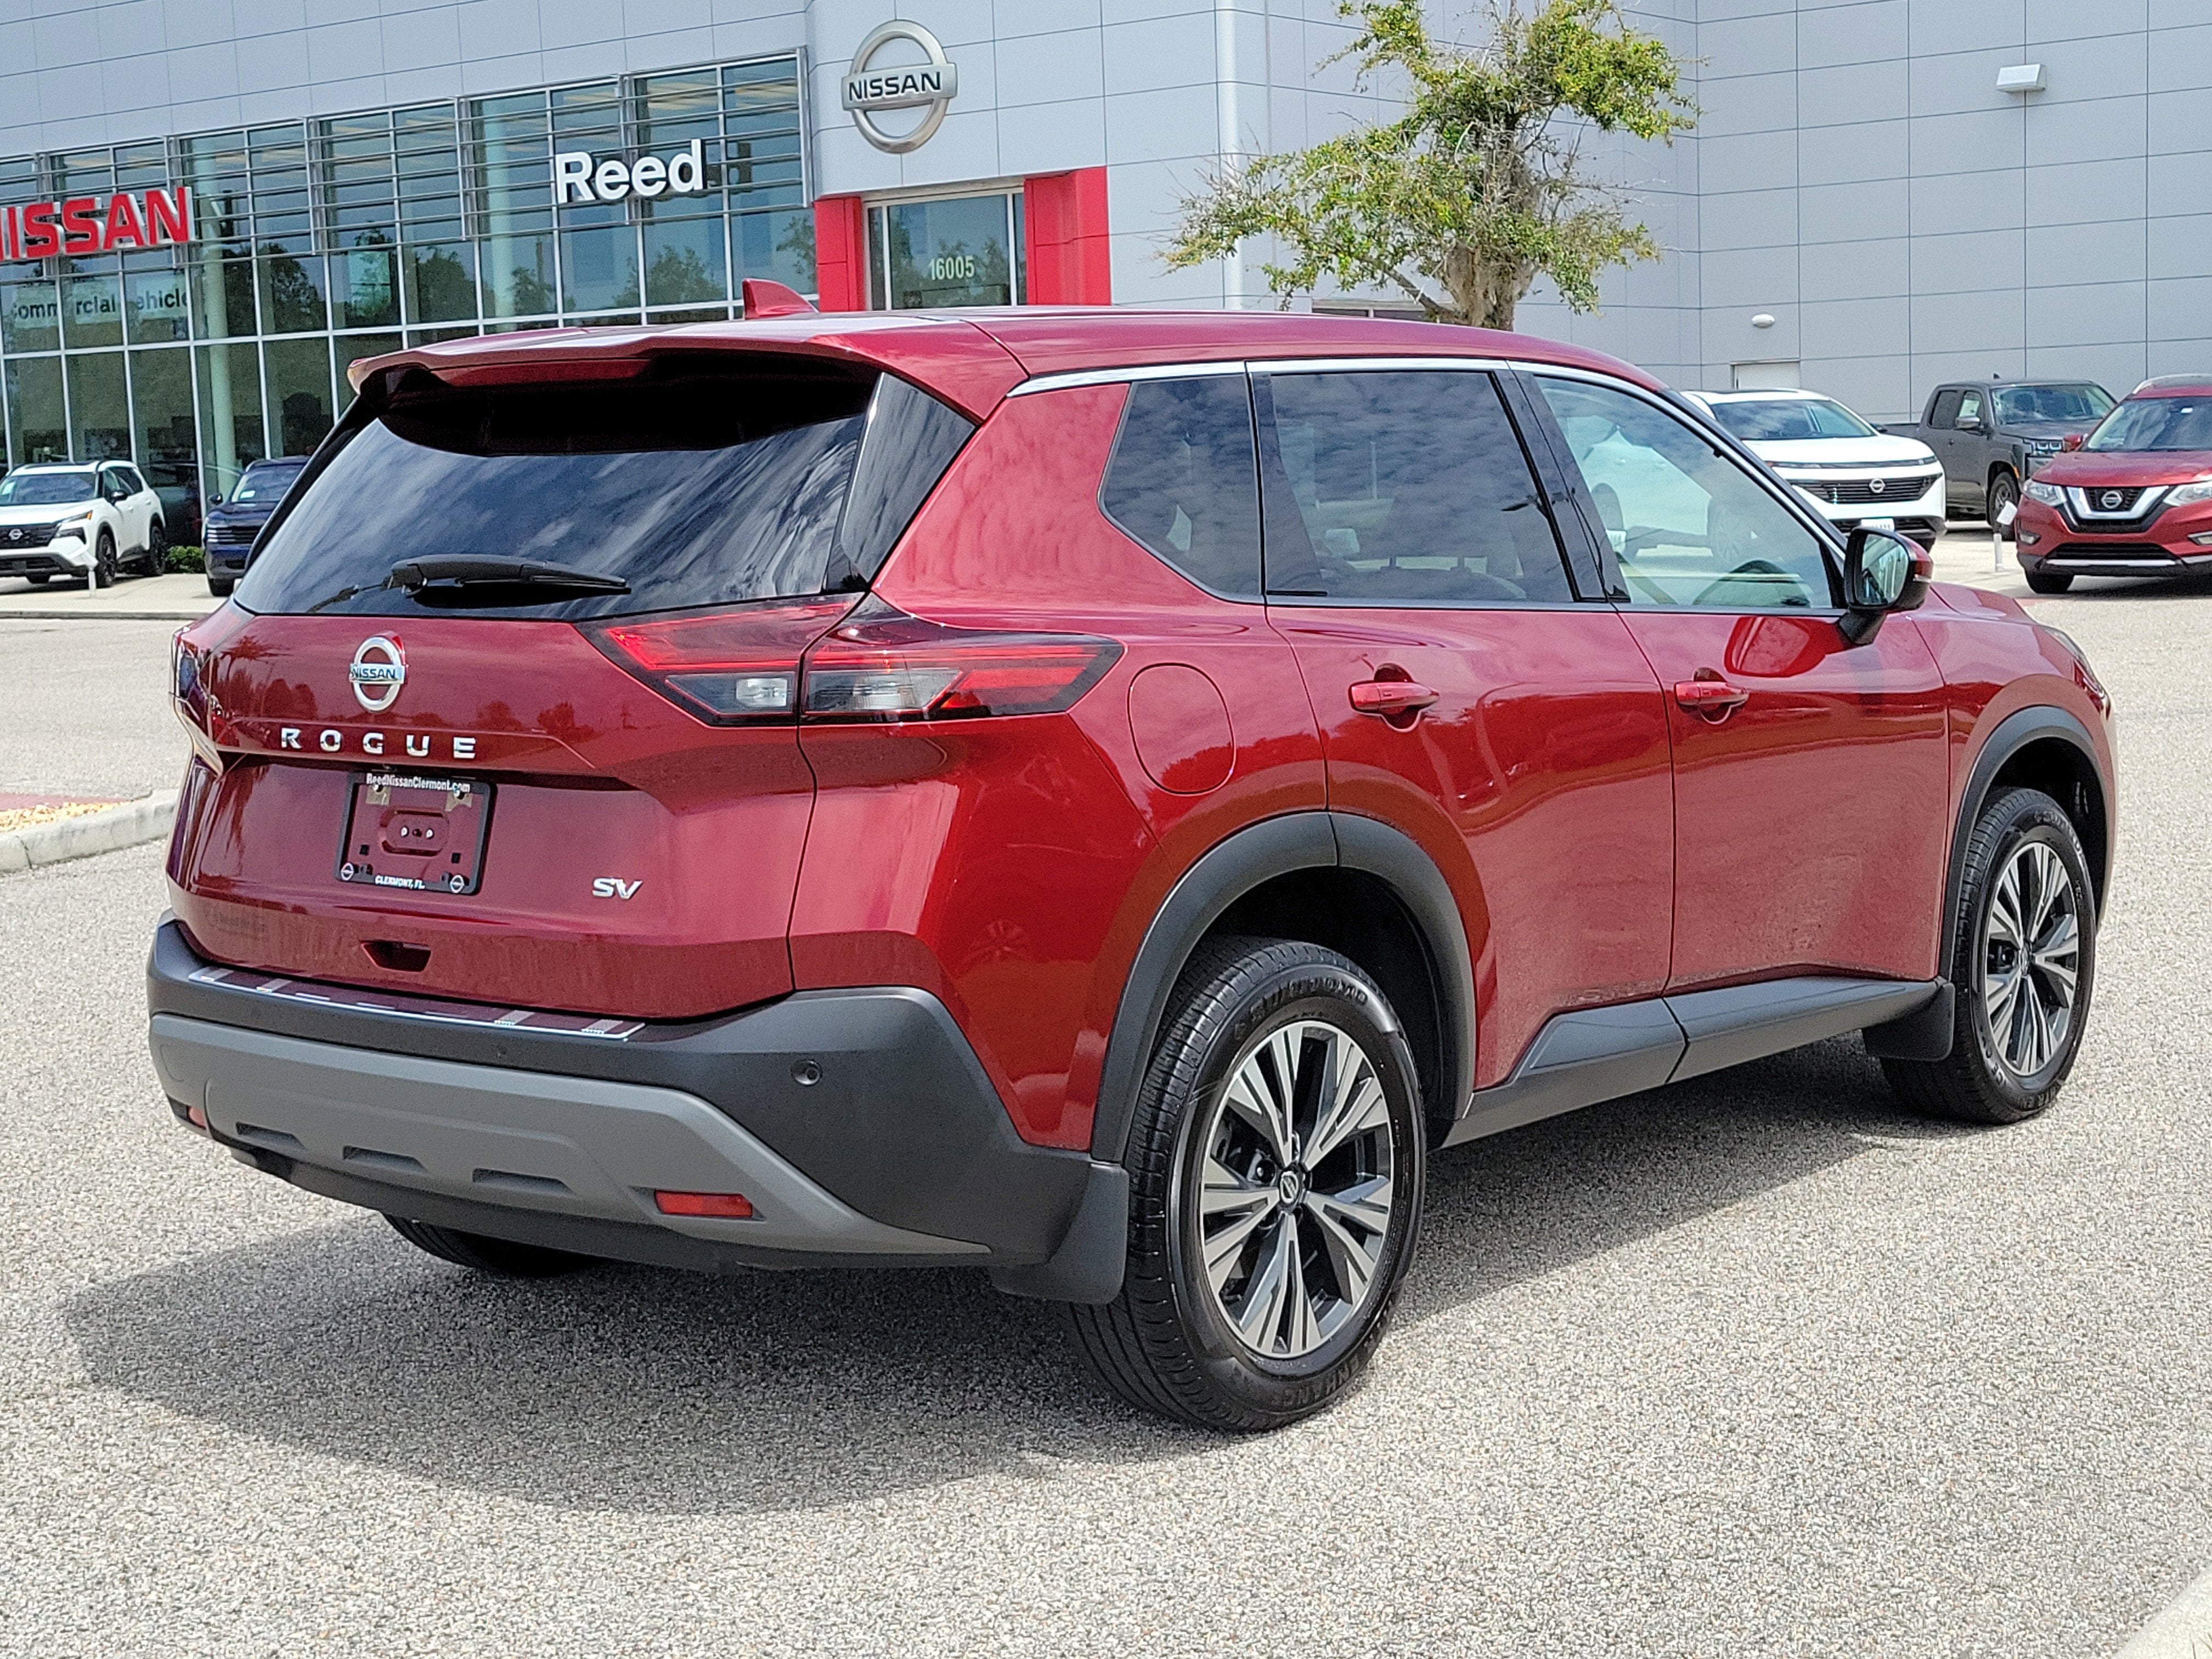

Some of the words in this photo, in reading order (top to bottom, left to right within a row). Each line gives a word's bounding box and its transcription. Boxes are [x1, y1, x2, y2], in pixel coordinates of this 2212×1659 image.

[848, 71, 941, 101] NISSAN
[555, 138, 704, 204] Reed
[928, 254, 975, 281] 16005
[352, 667, 396, 679] NISSAN
[280, 727, 477, 759] ROGUE
[366, 773, 471, 793] ReedNissanClermont.com
[592, 877, 644, 900] SV
